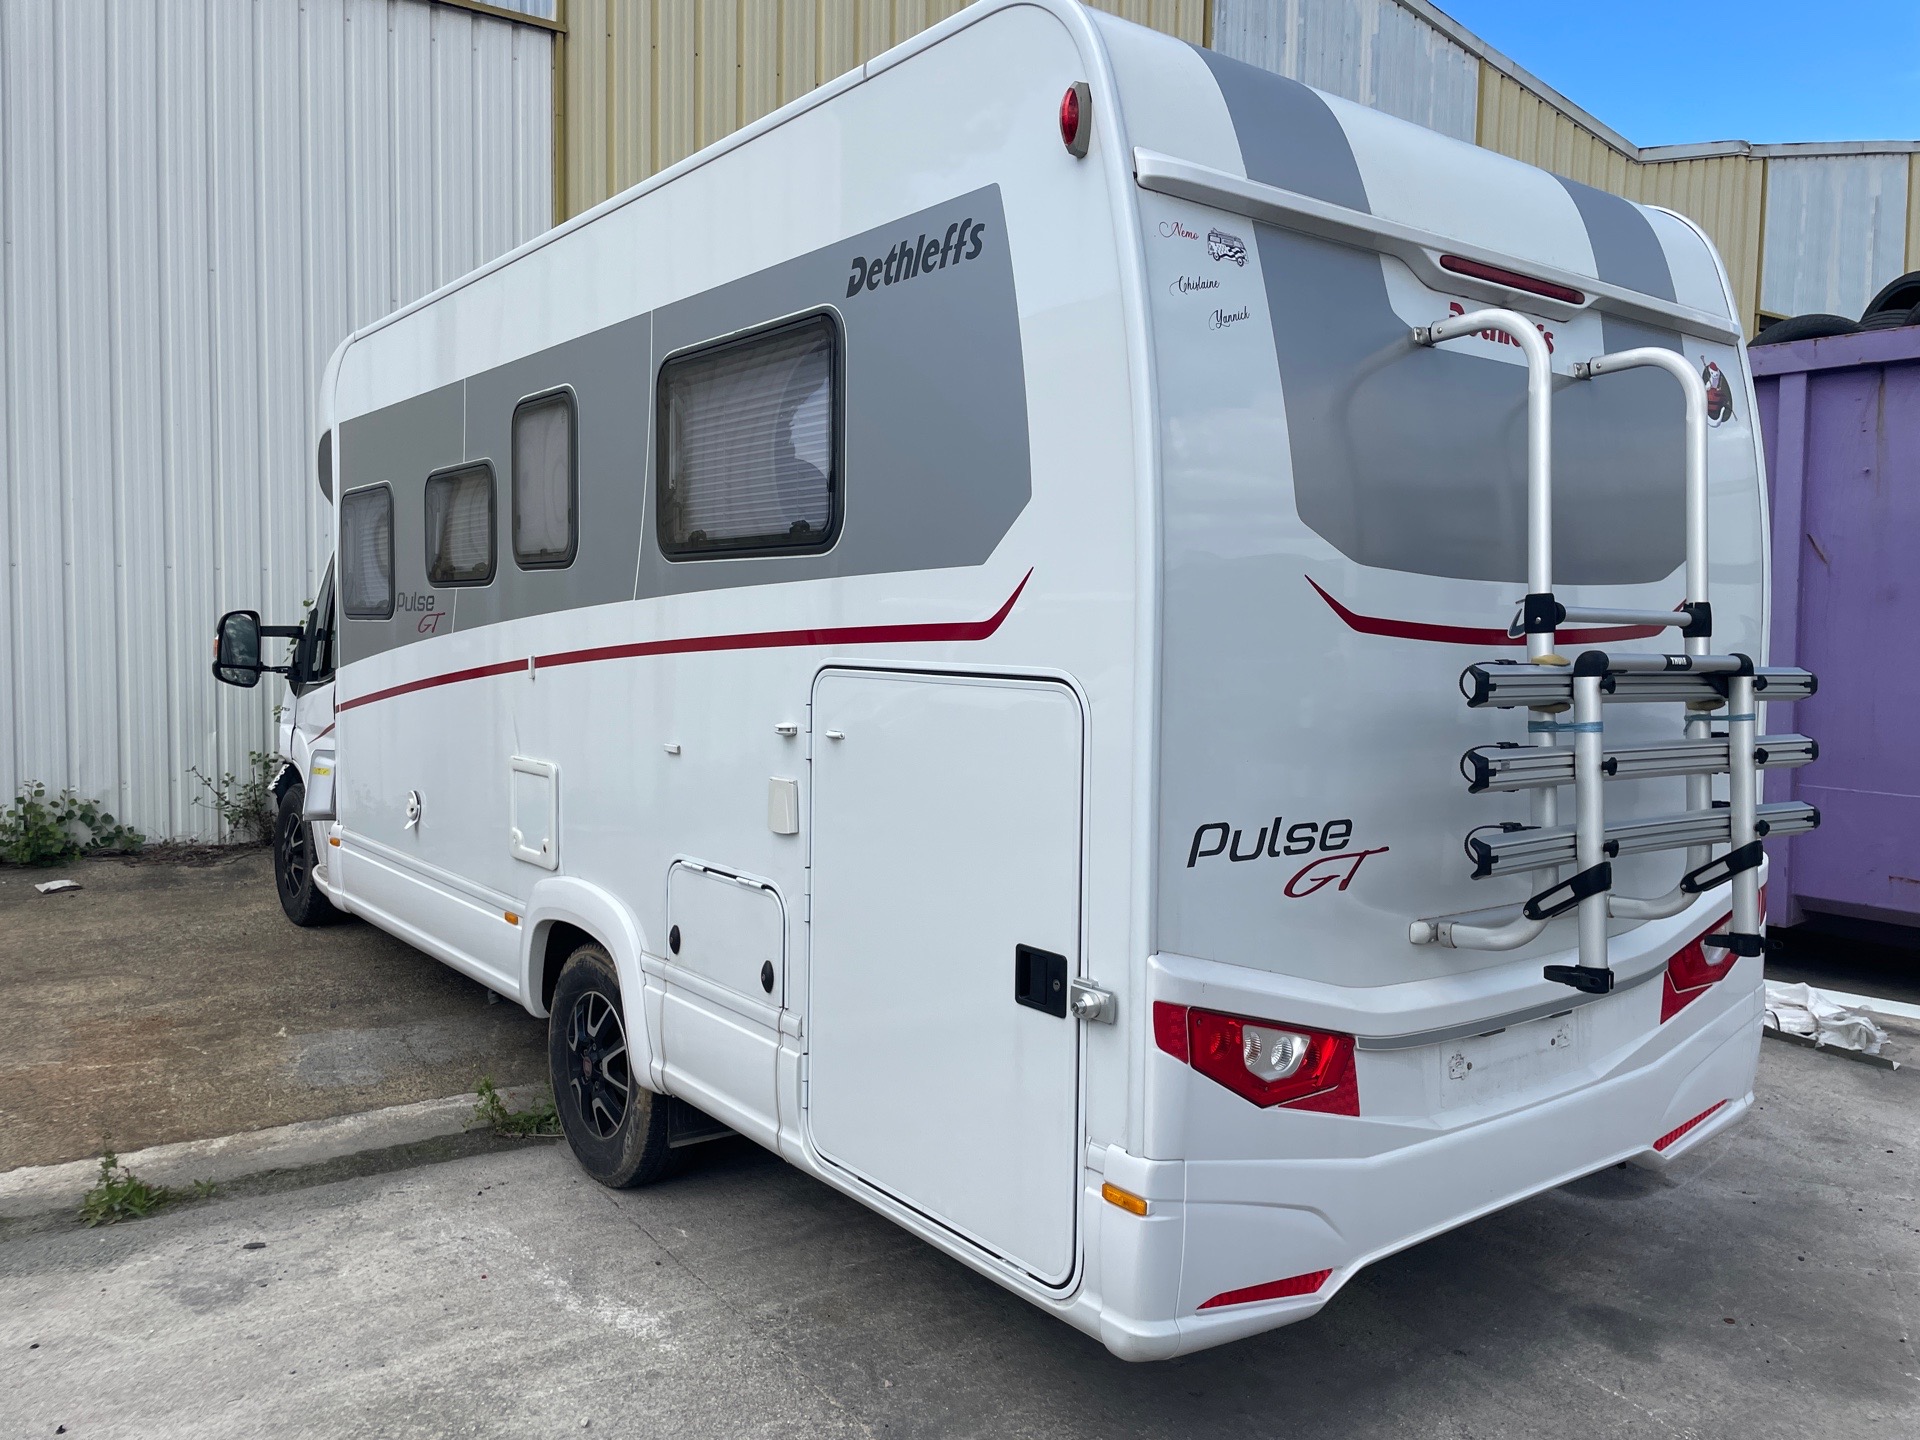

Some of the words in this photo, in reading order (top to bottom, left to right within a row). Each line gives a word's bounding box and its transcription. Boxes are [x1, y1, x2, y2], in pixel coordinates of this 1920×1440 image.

[1159, 221, 1199, 241] Nemo
[846, 218, 986, 298] Dethleffs
[1208, 305, 1250, 331] Yannick
[396, 591, 435, 612] Pulse
[417, 612, 446, 633] GT
[1187, 816, 1353, 868] Pulse
[1284, 846, 1390, 898] GT
